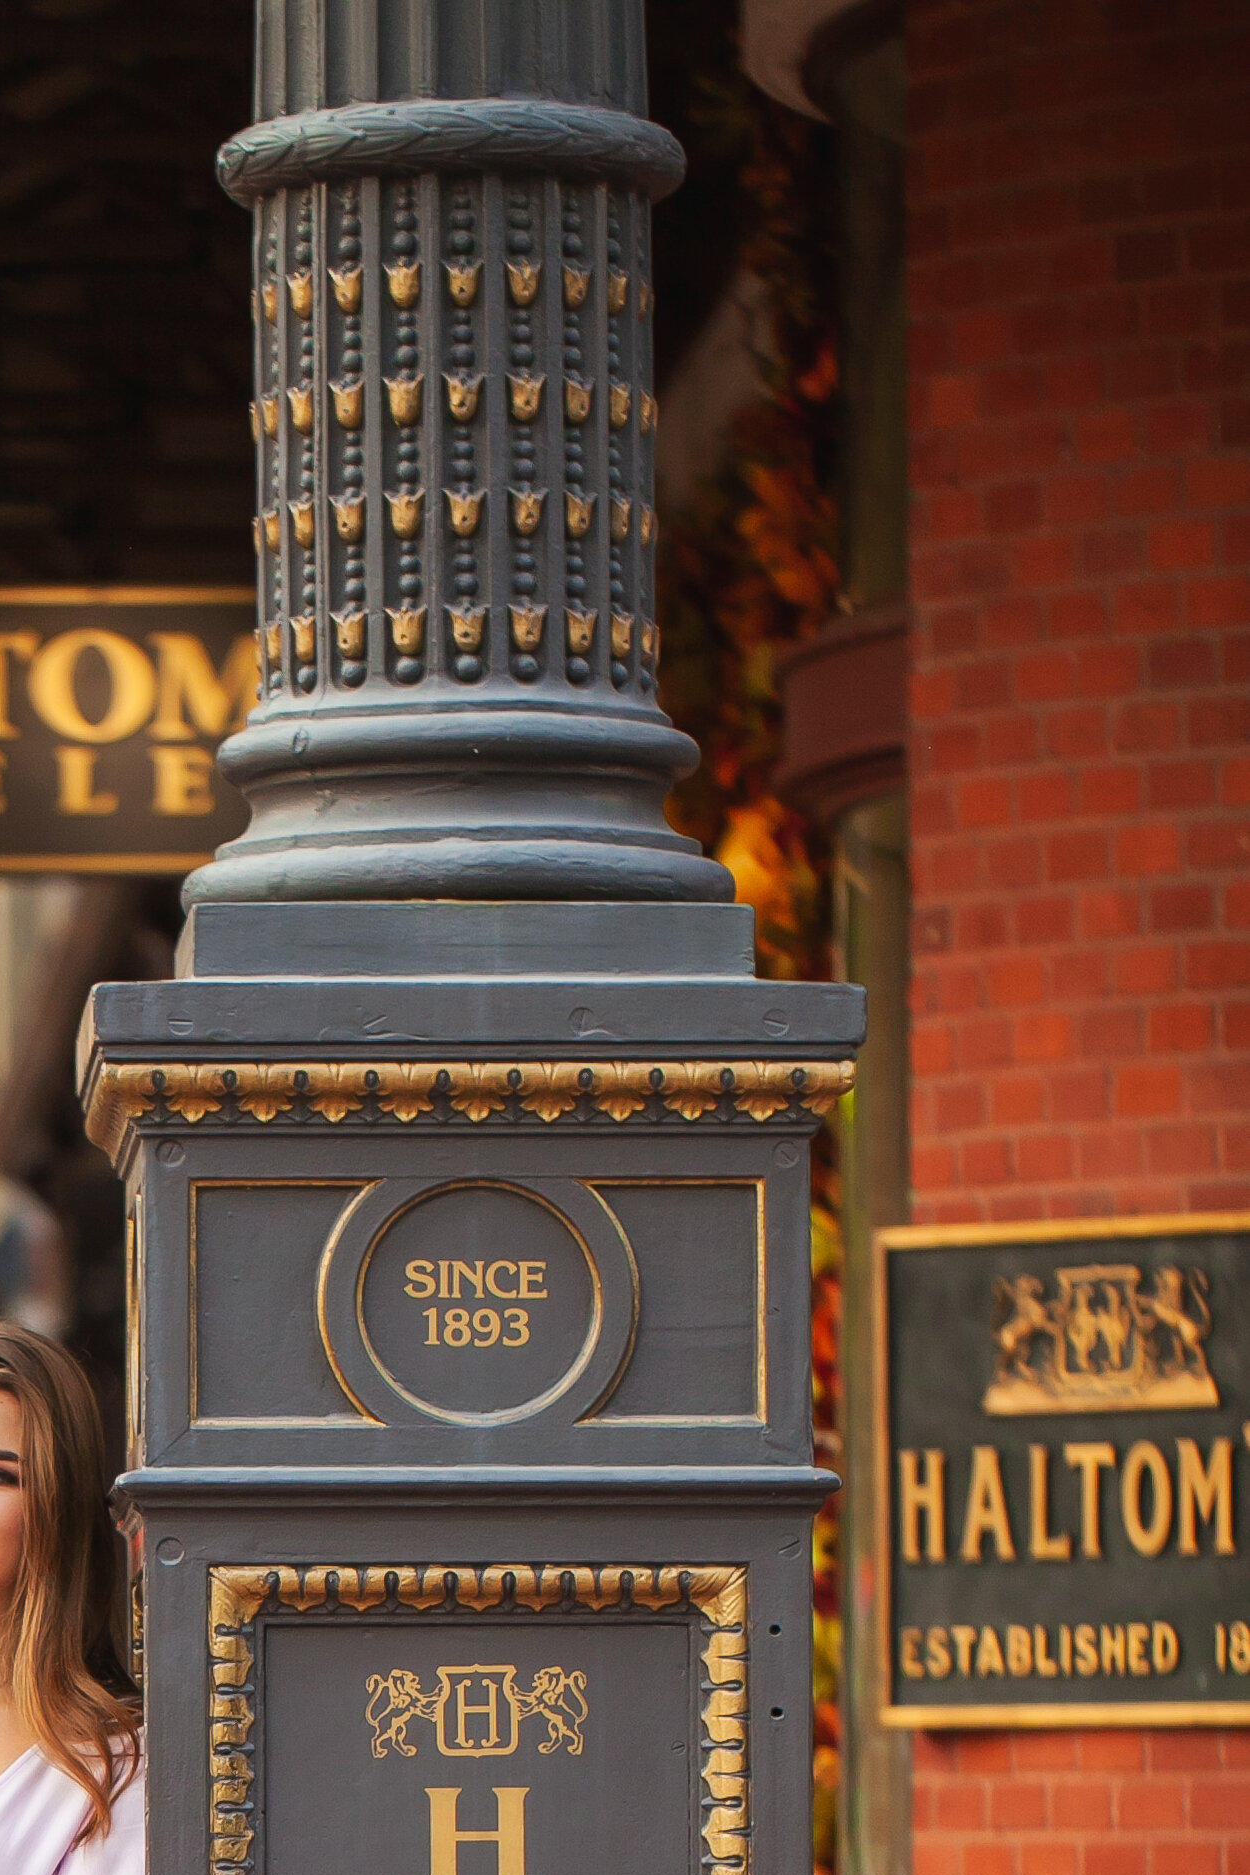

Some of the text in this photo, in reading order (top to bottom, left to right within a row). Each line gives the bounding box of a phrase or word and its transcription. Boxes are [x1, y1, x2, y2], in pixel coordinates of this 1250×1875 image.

[404, 1259, 548, 1299] SINCE
[422, 1307, 530, 1347] 1893
[901, 1620, 1250, 1678] ESTABLISHED 18
[455, 1679, 500, 1747] H
